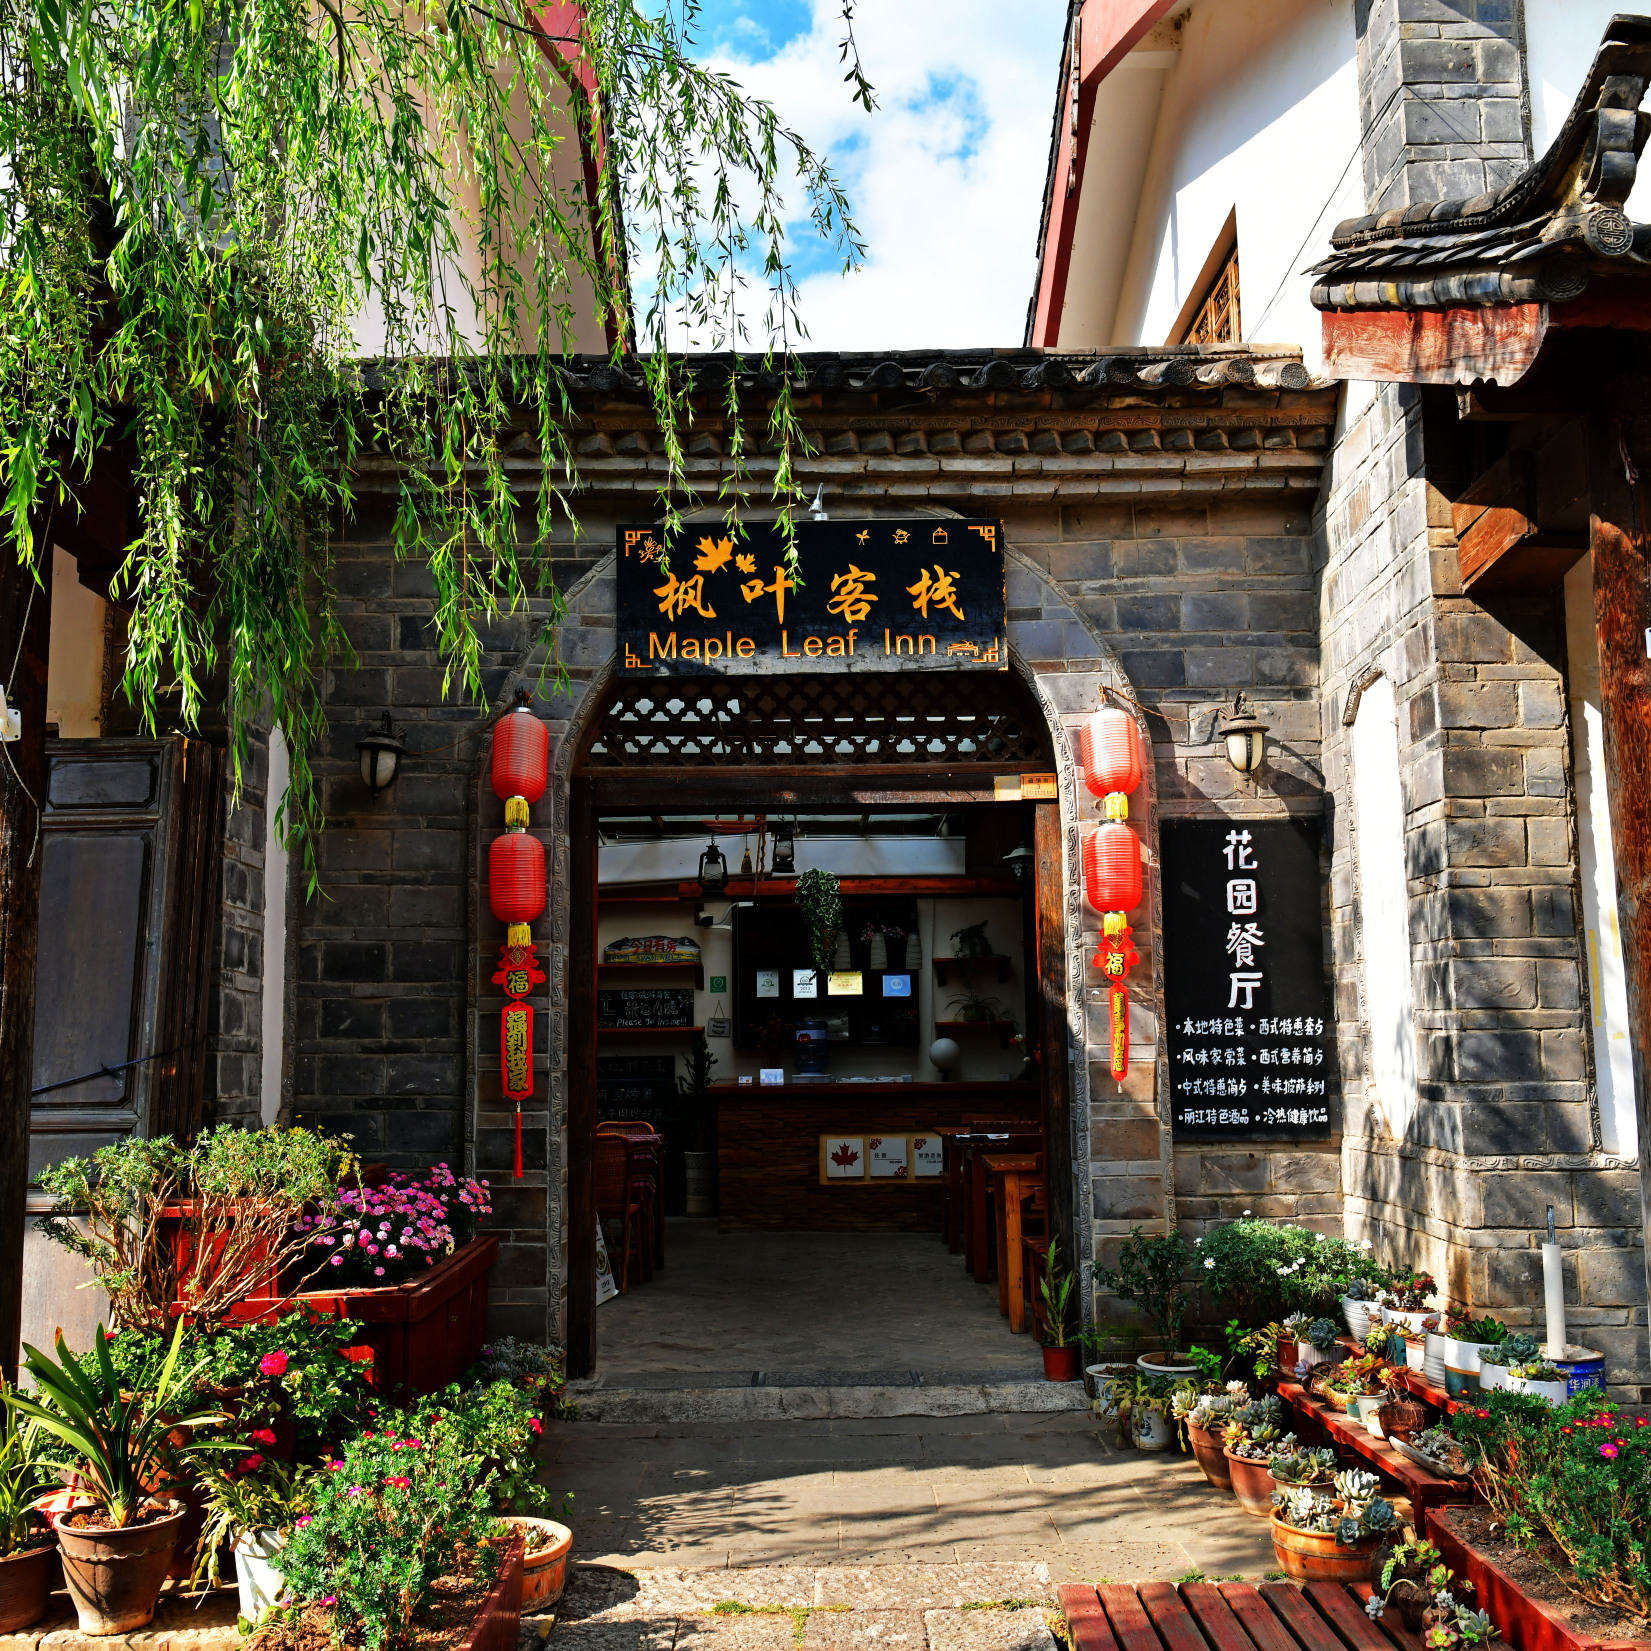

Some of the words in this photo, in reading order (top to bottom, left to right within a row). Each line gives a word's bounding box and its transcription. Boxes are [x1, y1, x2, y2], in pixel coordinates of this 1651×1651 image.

[653, 564, 965, 624] 枫叶客栈
[649, 629, 756, 665] Maple
[782, 628, 857, 658] Leaf
[884, 627, 937, 655] Inn
[1222, 830, 1265, 1009] 花园餐厅
[630, 938, 677, 953] 今日有房
[1105, 952, 1125, 975] 福
[507, 970, 529, 994] 福
[616, 1018, 642, 1028] Please
[1183, 1016, 1245, 1037] 本地特色菜
[506, 1009, 529, 1092] 福到我家
[1182, 1046, 1247, 1066] 风味家常菜
[1261, 1076, 1325, 1095] 美味披萨系列
[1184, 1108, 1249, 1125] 丽江特色酒品
[1263, 1107, 1328, 1126] 冷热健康饮品
